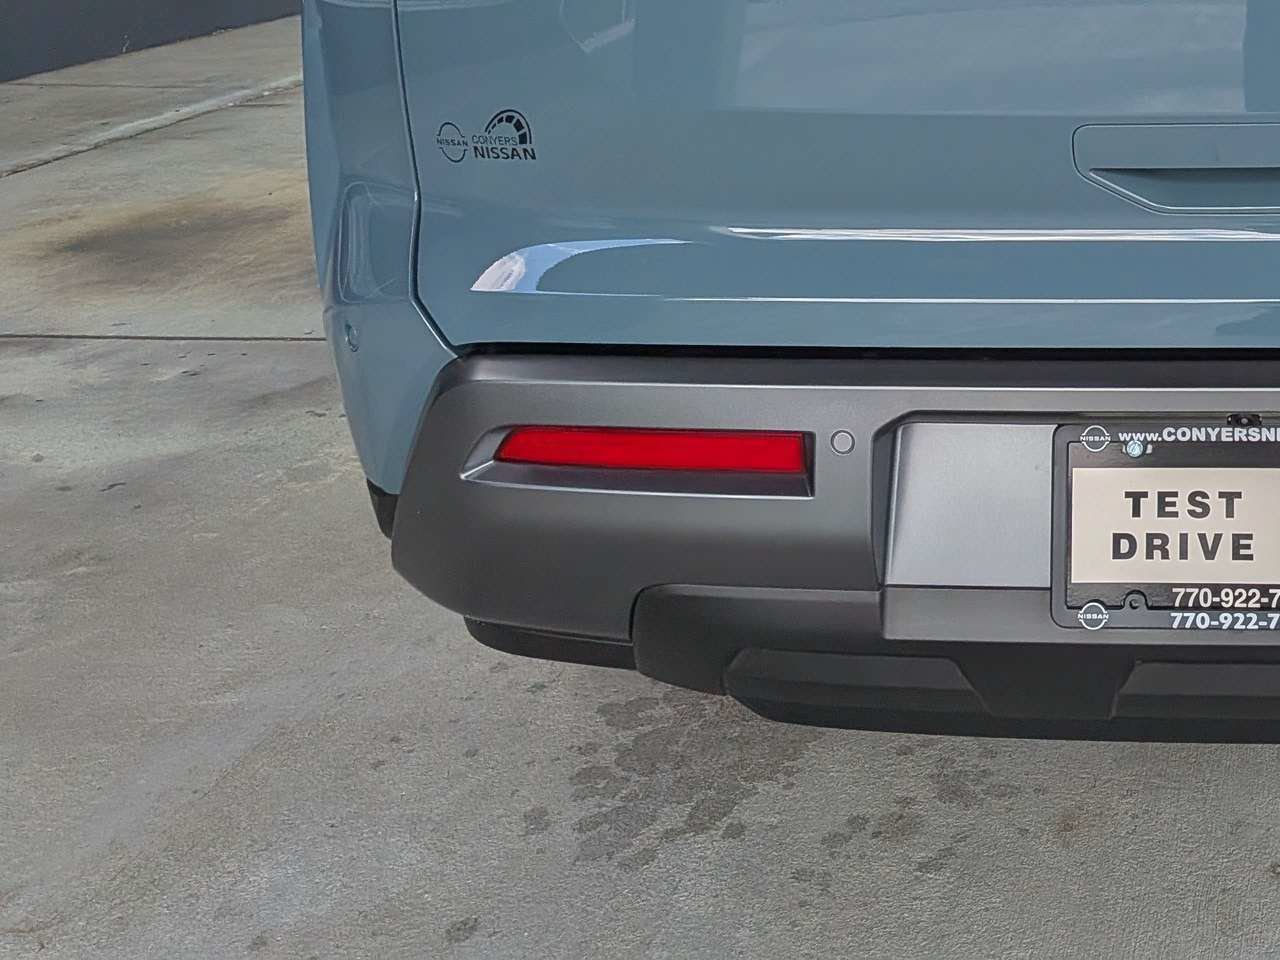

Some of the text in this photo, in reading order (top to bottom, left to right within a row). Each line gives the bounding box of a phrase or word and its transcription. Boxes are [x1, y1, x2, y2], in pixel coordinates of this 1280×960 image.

[436, 137, 469, 147] NISSAN
[471, 134, 519, 147] CONYERS
[473, 145, 537, 161] NISSAN
[1124, 490, 1243, 519] TEST
[1111, 532, 1255, 561] DRIVE
